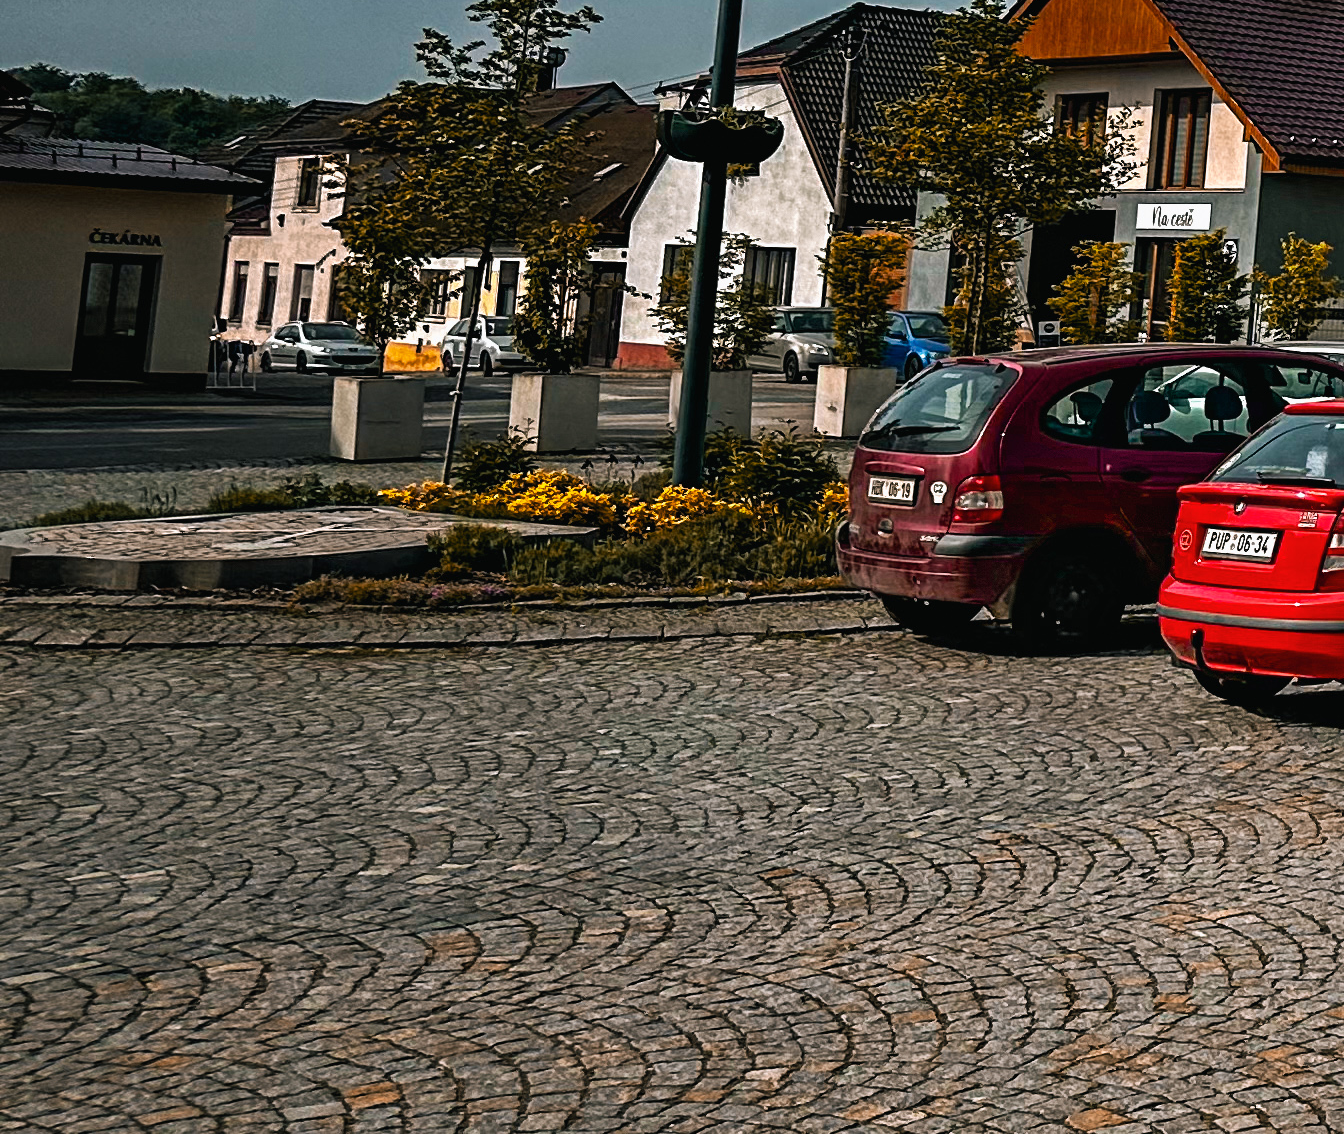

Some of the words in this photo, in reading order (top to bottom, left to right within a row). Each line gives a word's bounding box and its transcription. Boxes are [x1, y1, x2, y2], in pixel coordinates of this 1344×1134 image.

[1152, 206, 1168, 226] Na
[1170, 208, 1194, 226] cestě
[89, 228, 162, 246] ČEKÁRNA
[1208, 532, 1230, 549] PUP
[1236, 533, 1270, 554] 06-34
